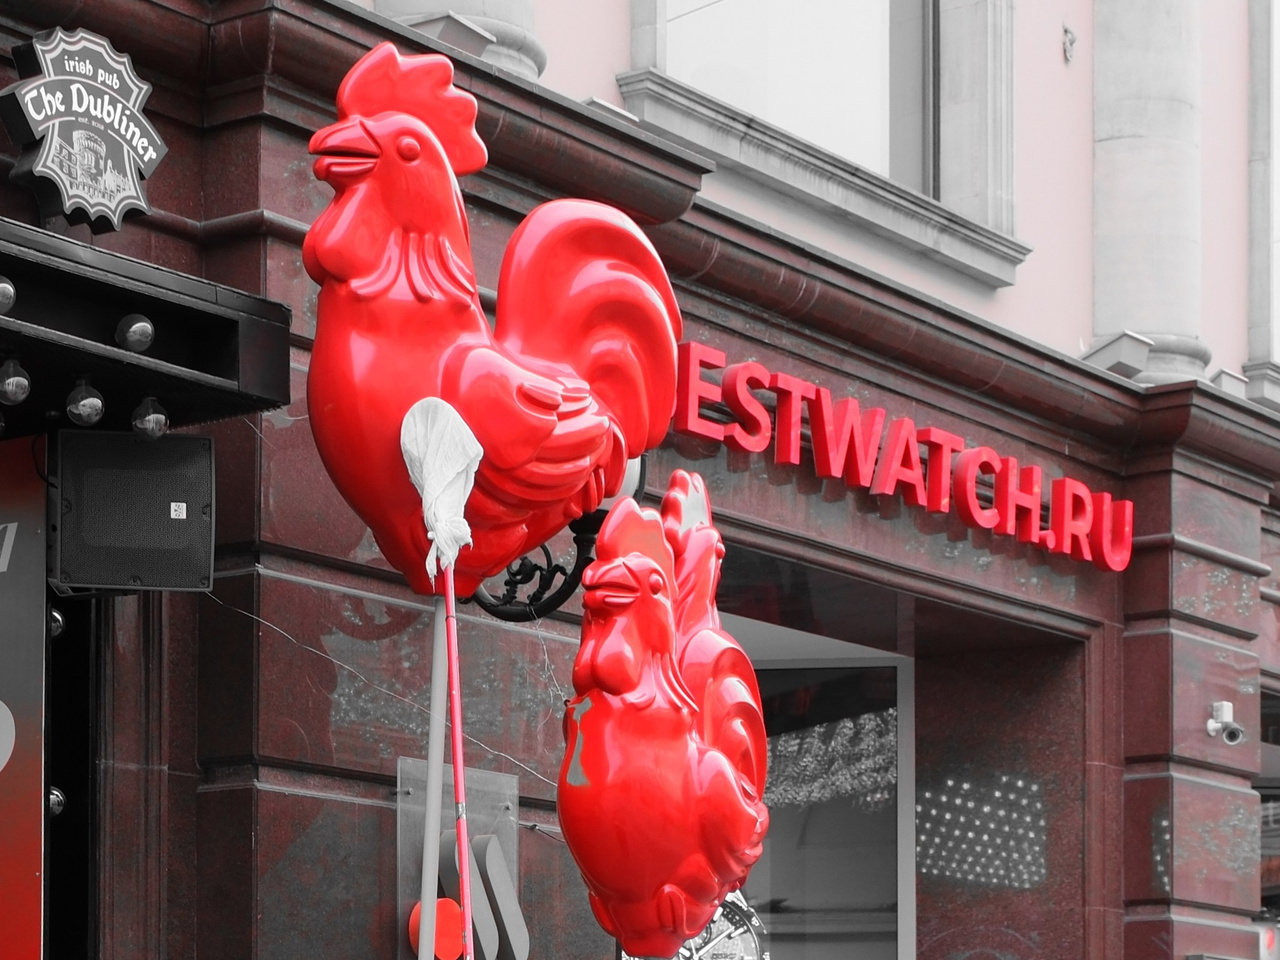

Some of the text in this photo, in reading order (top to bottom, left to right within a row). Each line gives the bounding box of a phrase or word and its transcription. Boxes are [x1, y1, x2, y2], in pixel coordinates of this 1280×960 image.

[64, 55, 121, 90] irish pub
[24, 82, 157, 162] The Dubliner
